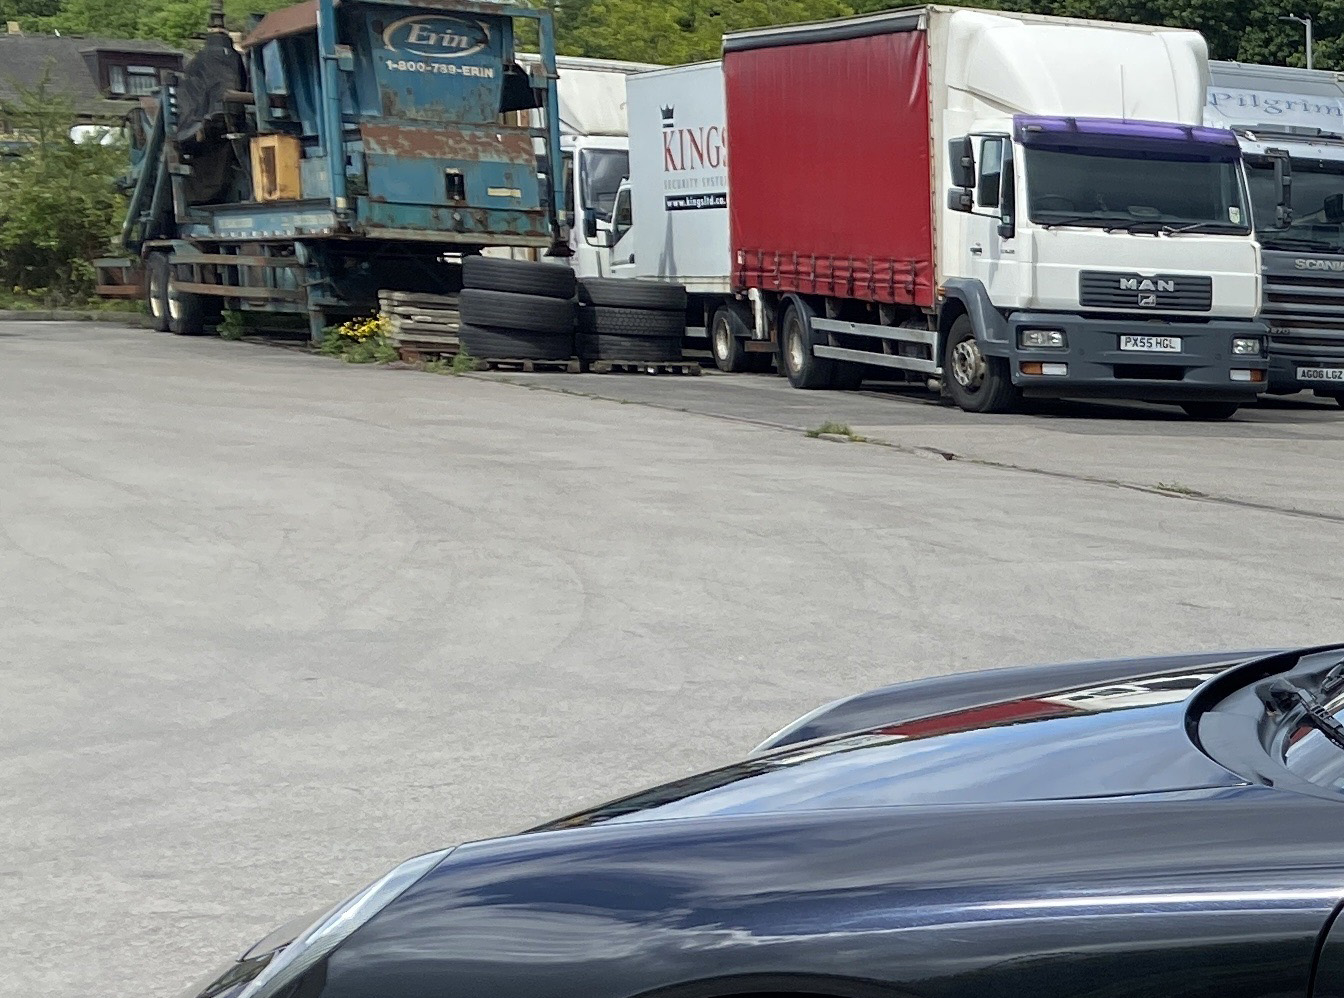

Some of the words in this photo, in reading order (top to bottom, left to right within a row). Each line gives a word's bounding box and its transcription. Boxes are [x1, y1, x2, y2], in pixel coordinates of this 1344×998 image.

[404, 22, 468, 48] Erin
[1209, 92, 1343, 117] Pilgrim
[664, 179, 699, 190] SECURITY
[1119, 278, 1174, 292] MAN
[1124, 336, 1152, 349] PX55
[1156, 338, 1176, 350] HGL
[1301, 369, 1323, 379] AG06
[1326, 370, 1342, 380] LGZ
